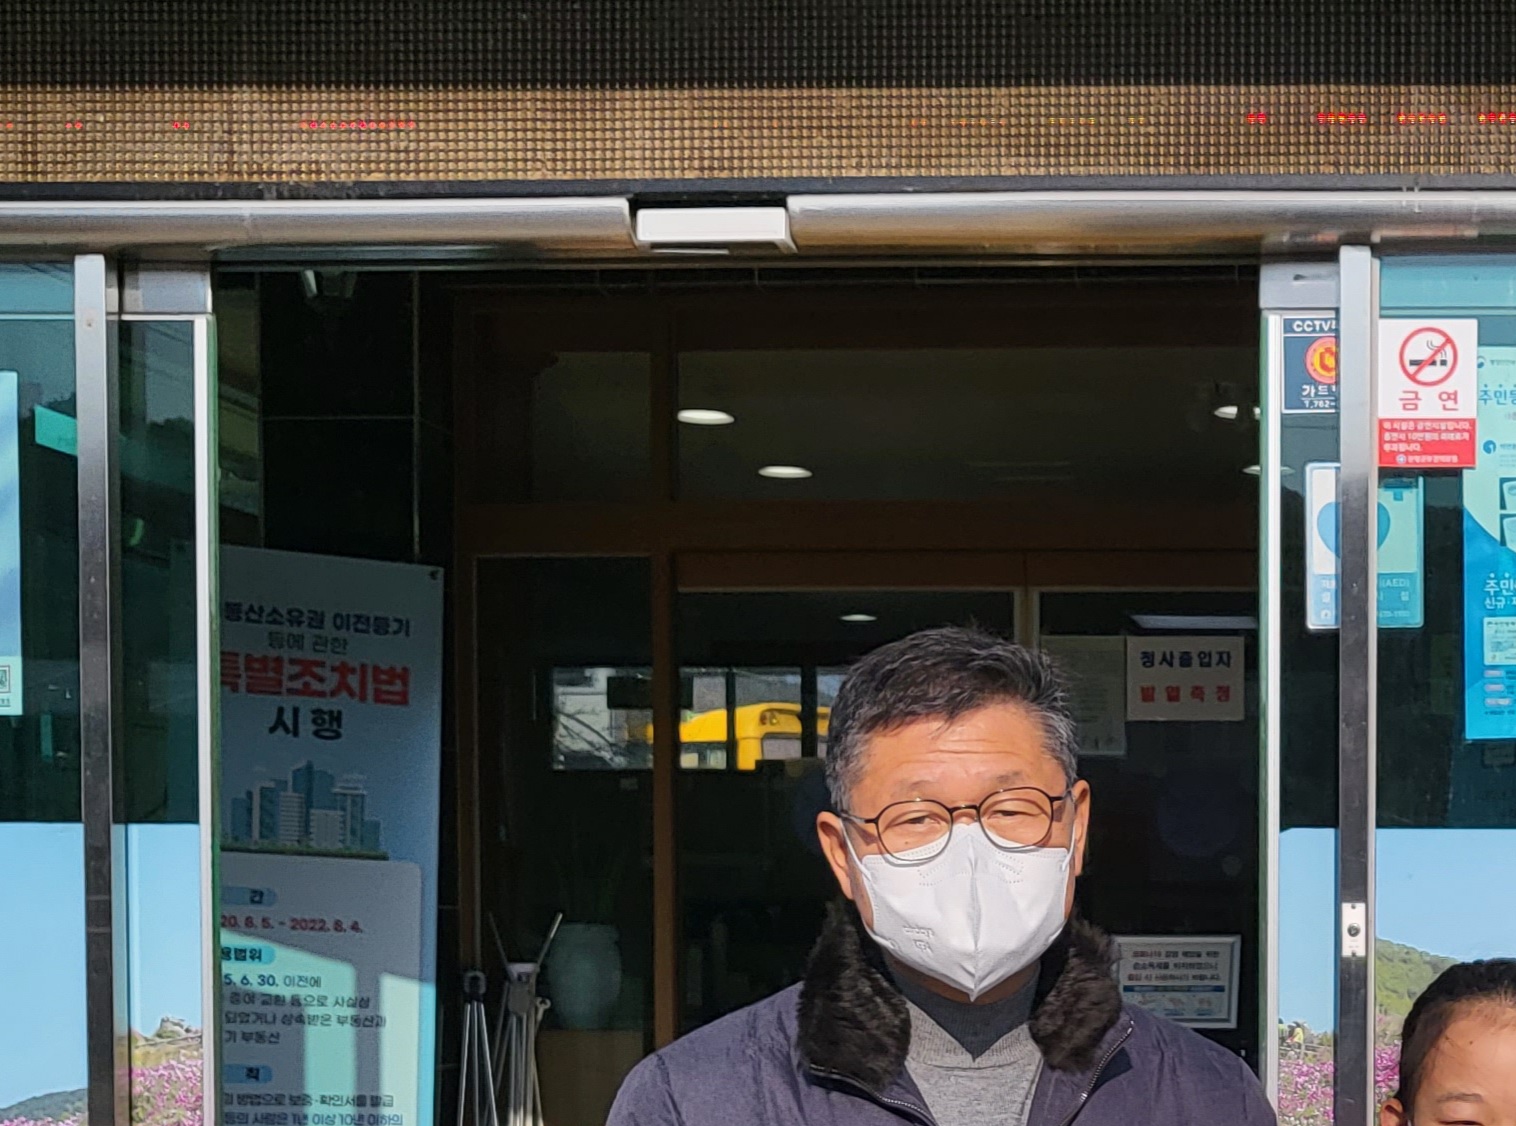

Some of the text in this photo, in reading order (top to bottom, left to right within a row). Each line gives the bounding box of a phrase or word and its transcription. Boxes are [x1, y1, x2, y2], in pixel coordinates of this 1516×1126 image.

[312, 634, 347, 655] 관한
[1140, 651, 1232, 668] 청사출입자
[257, 975, 279, 987] 30.
[283, 975, 322, 988] 이전에
[312, 1113, 336, 1125] 이상
[341, 1113, 364, 1126] 10년
